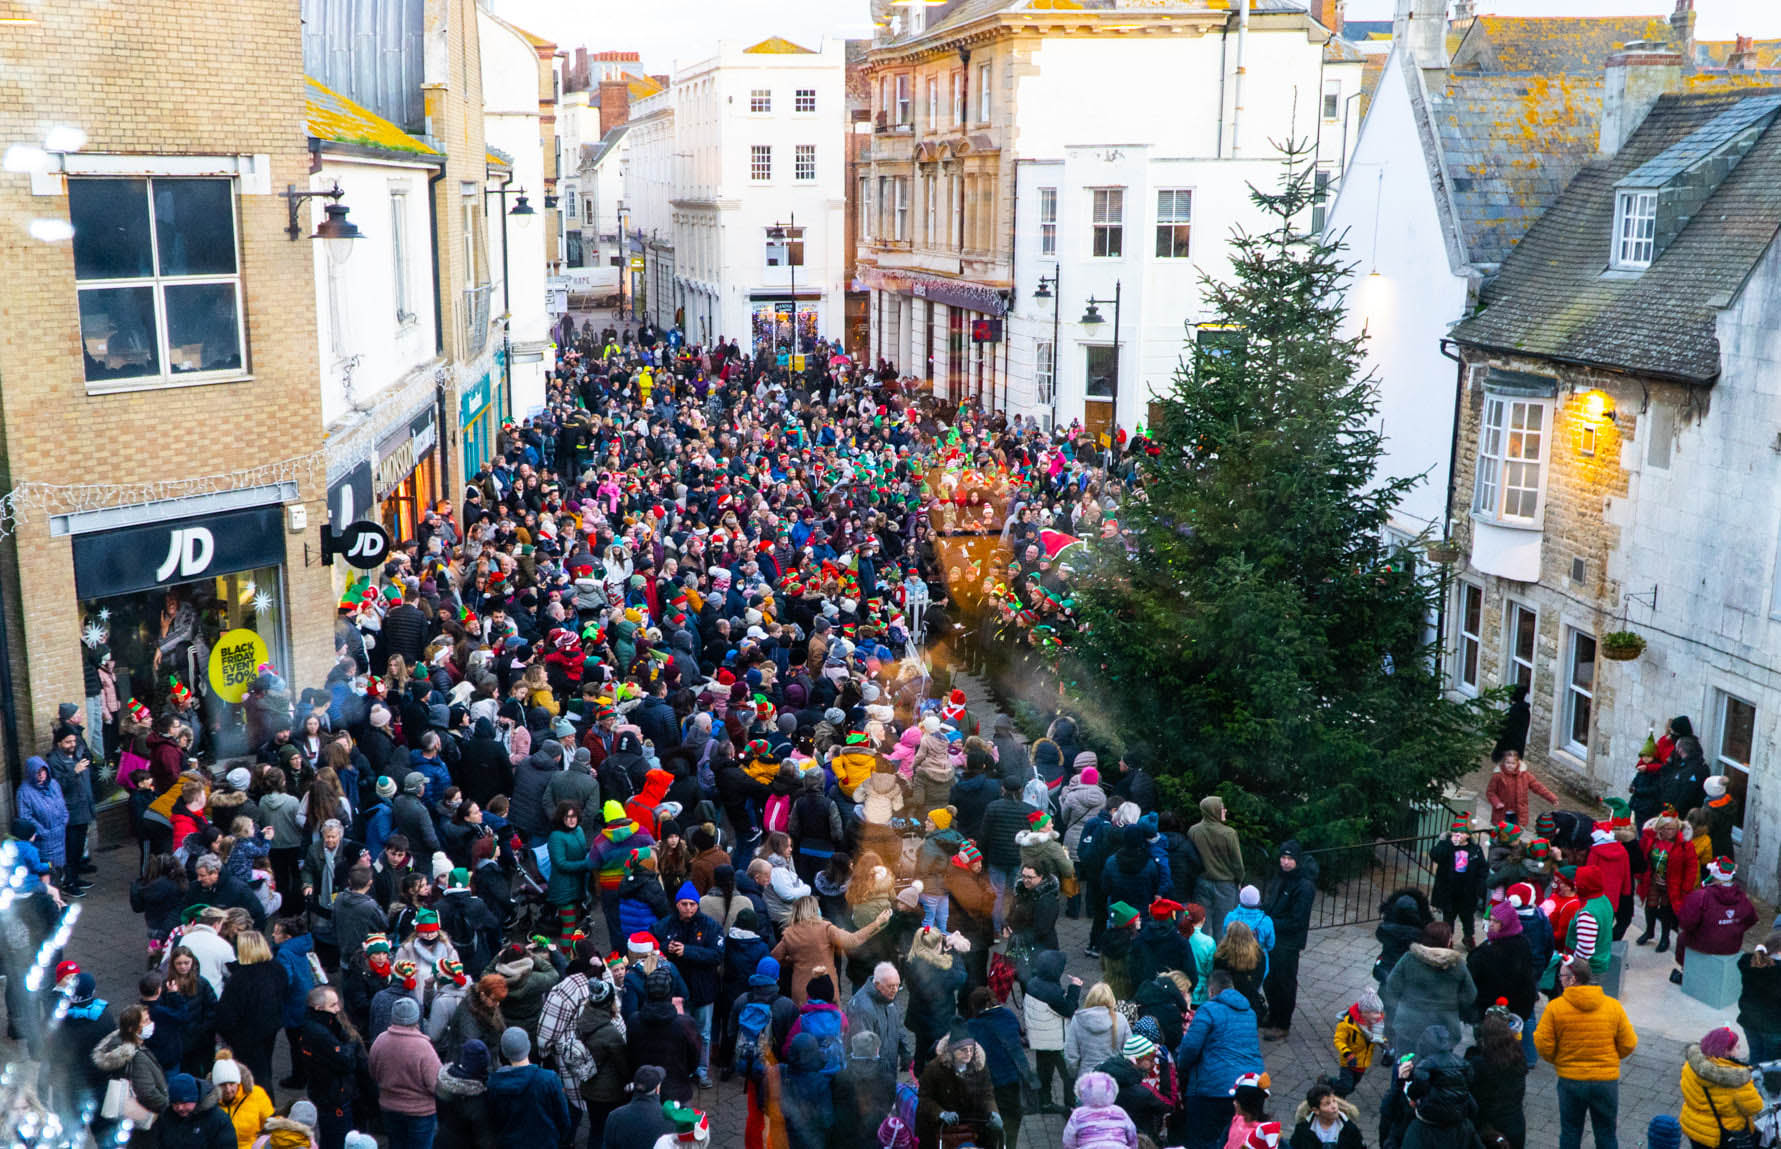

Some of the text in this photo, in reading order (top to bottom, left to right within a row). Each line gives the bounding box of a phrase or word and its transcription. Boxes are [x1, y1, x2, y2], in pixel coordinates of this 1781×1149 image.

[347, 532, 384, 557] JD
[156, 526, 215, 583] JD
[221, 641, 255, 656] BLACK
[222, 651, 255, 664] FRIDAY
[223, 659, 256, 674] EVENT
[226, 670, 256, 686] 50%
